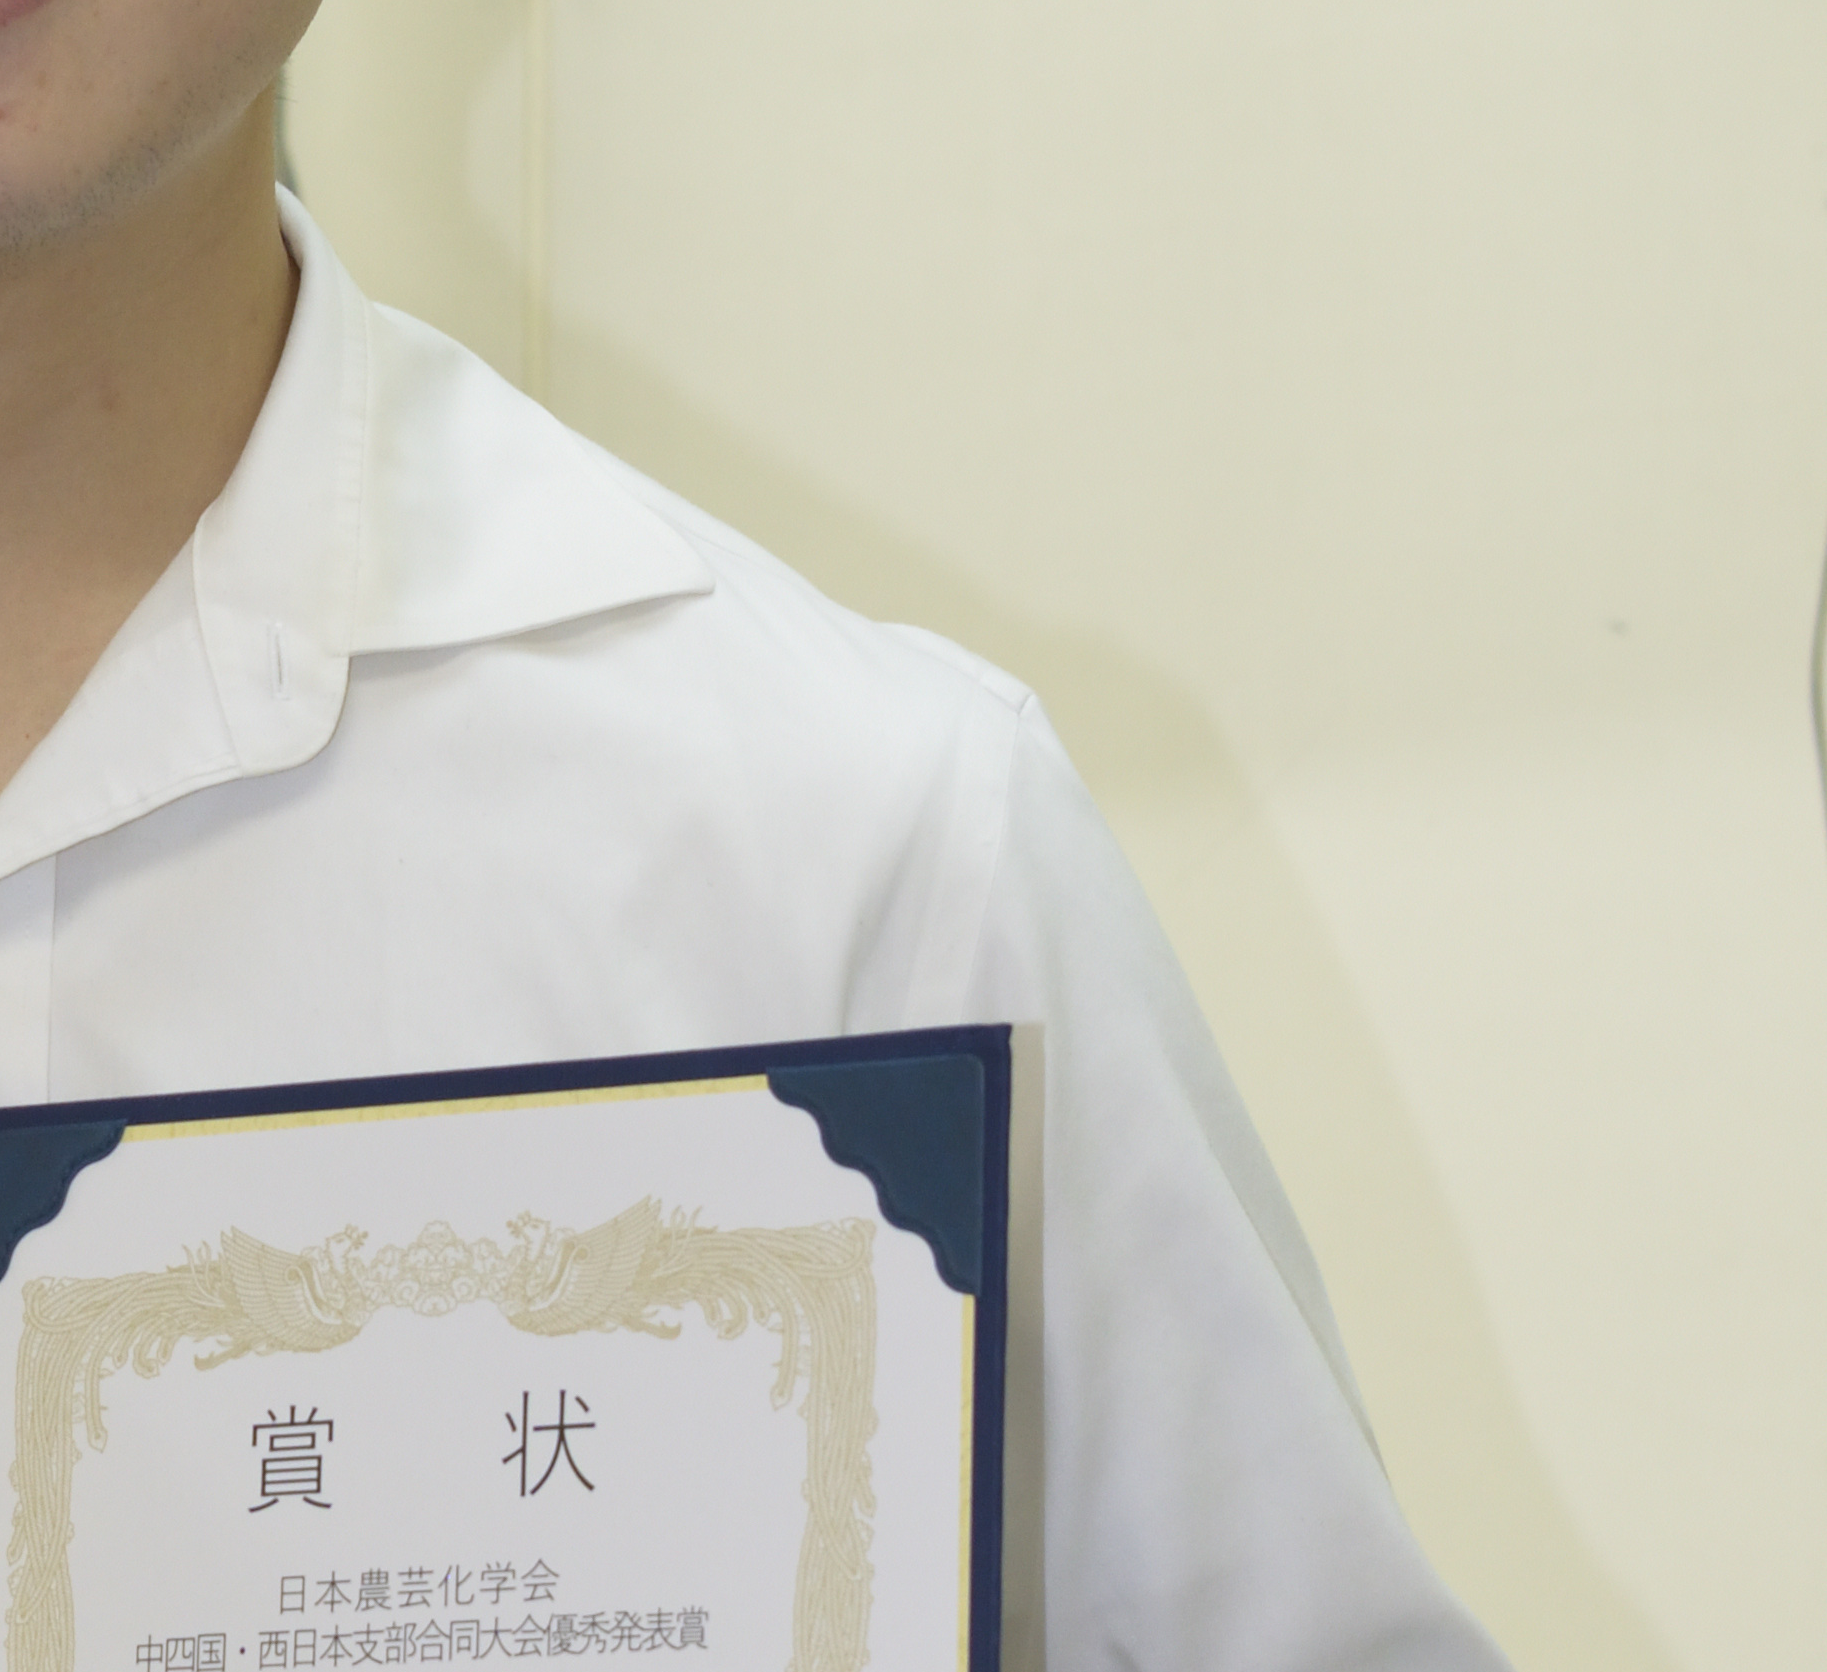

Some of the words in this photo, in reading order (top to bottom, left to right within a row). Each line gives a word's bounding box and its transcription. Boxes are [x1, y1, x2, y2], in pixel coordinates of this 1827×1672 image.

[280, 1559, 559, 1615] 日本農芸化学会
